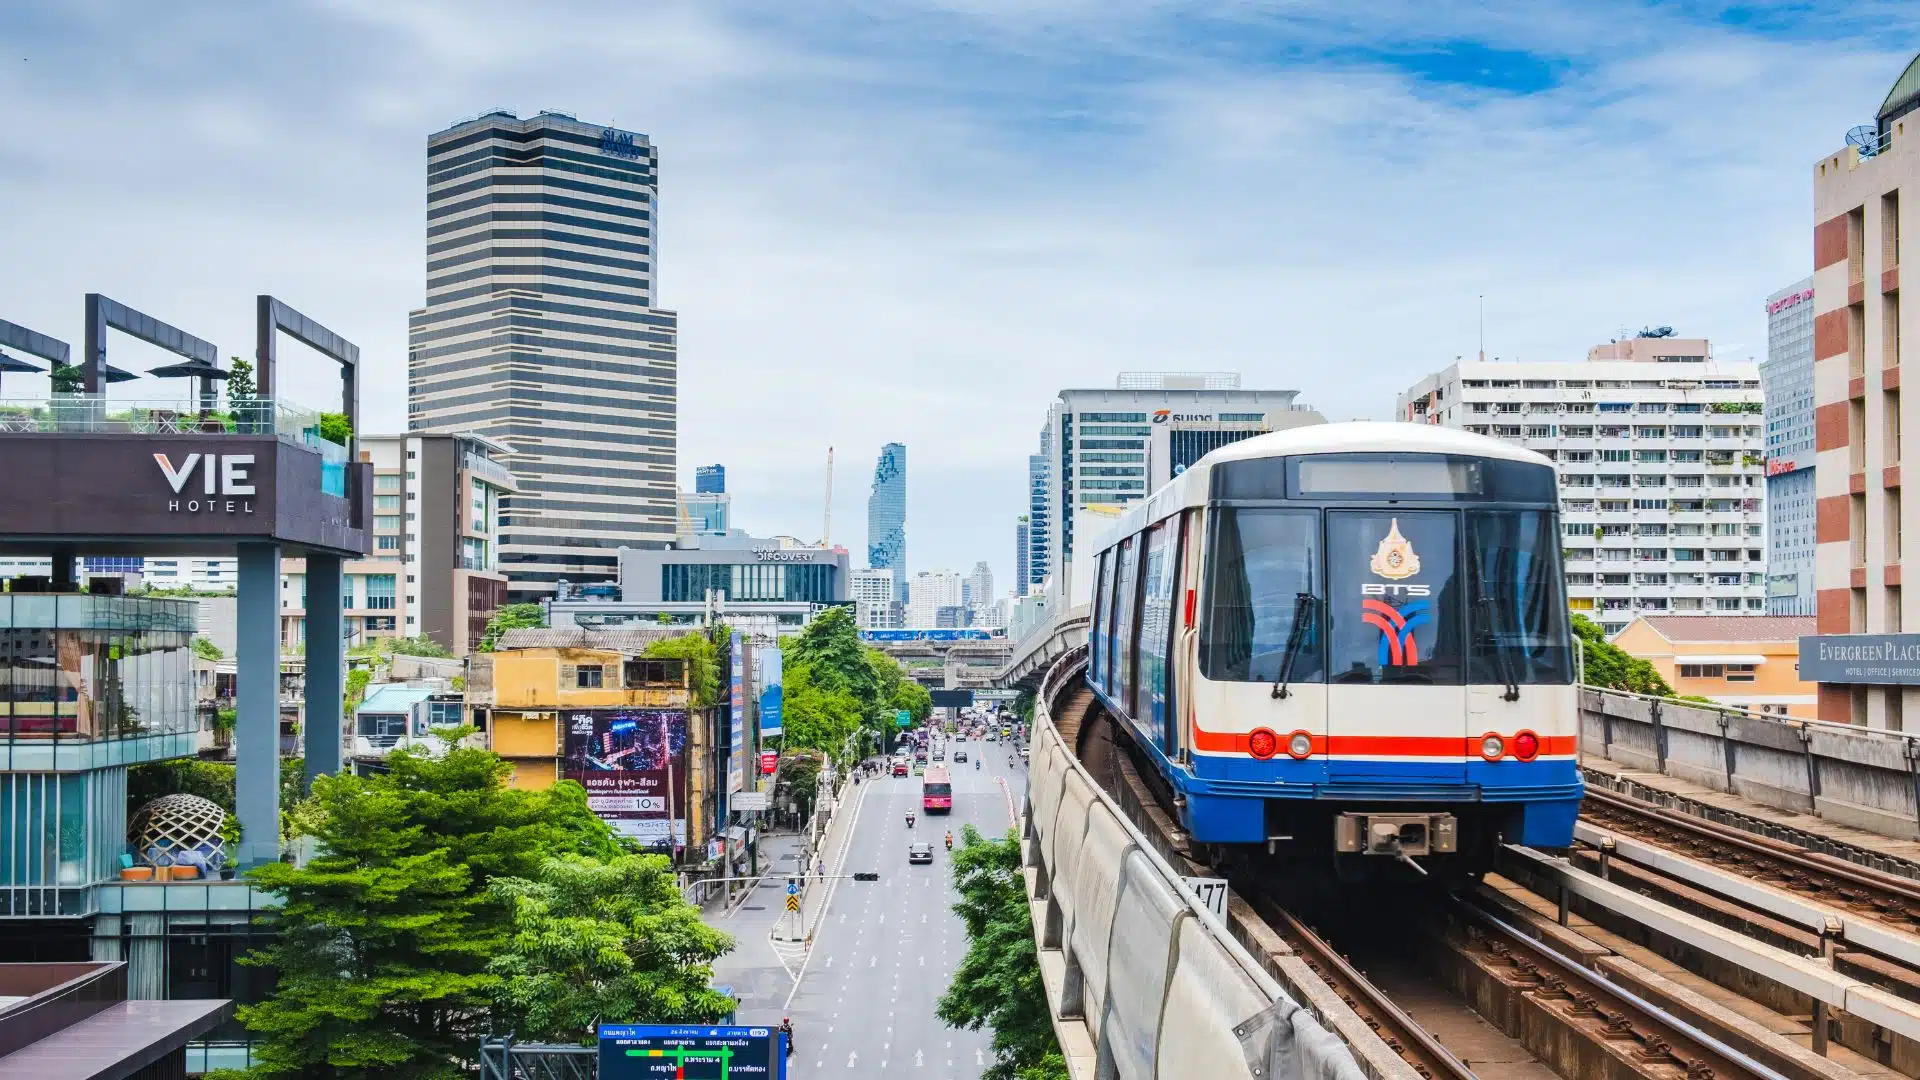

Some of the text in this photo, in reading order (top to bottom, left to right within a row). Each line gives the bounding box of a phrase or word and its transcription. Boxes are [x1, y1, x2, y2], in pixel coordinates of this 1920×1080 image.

[153, 453, 256, 495] VIE
[169, 500, 253, 513] HOTEL
[757, 552, 815, 561] DISCOVERY
[1361, 583, 1431, 596] BTS
[1845, 668, 1863, 676] HOTEL
[1867, 668, 1888, 676] OFFICE
[636, 798, 651, 809] 10
